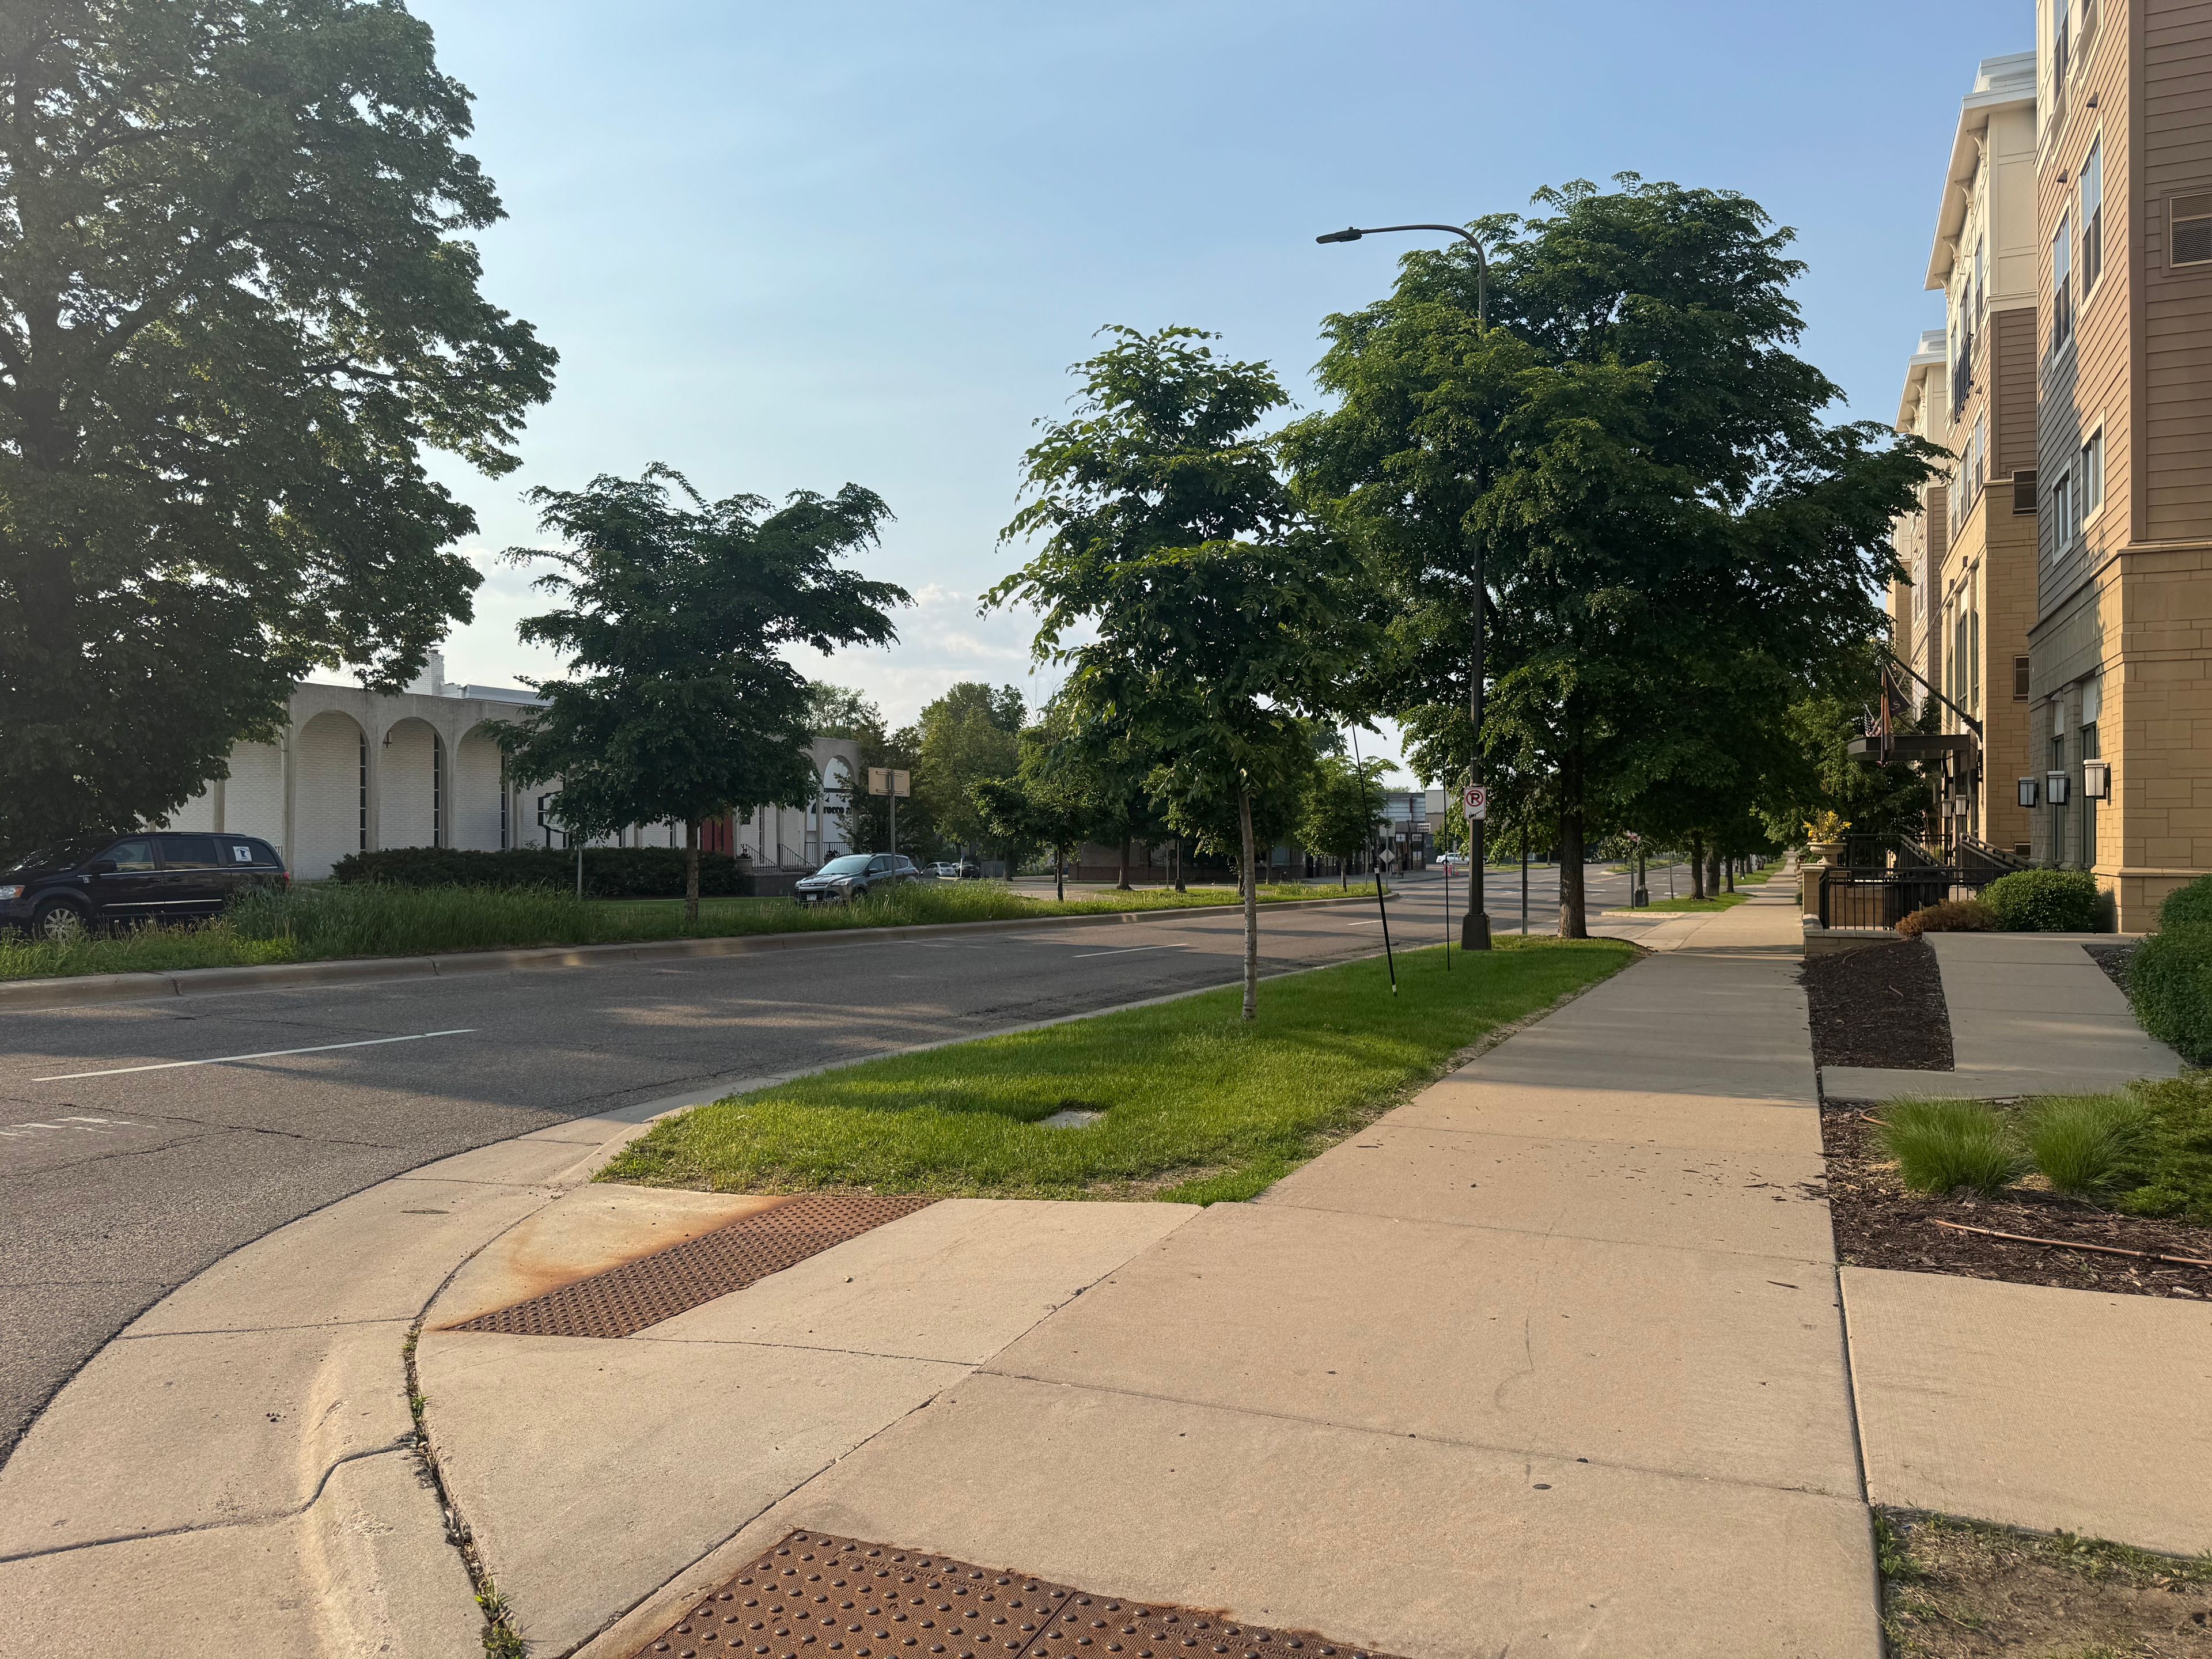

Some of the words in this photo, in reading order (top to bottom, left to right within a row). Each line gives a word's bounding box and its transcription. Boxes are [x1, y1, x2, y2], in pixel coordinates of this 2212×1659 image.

[942, 1576, 994, 1592] COMPANY
[1138, 1620, 1190, 1635] NEENAH
[1192, 1633, 1252, 1649] FOUNDRY
